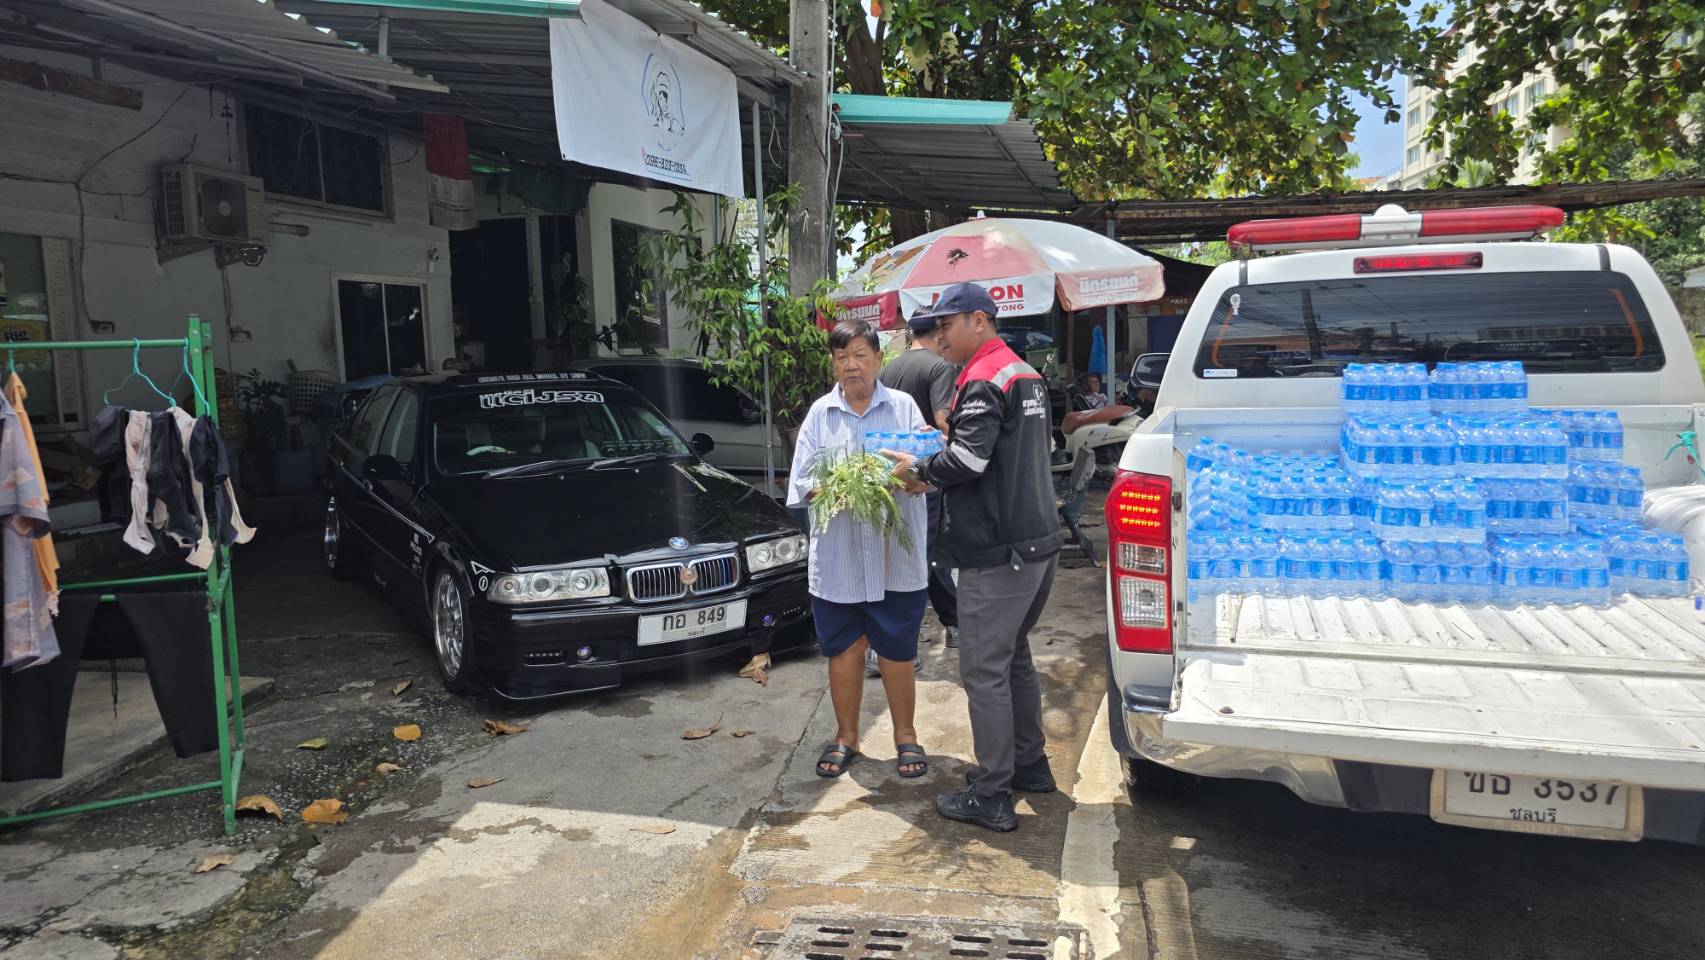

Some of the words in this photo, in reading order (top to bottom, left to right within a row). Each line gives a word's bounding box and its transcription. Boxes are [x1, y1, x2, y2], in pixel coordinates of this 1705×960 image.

[663, 613, 686, 631] กอ
[697, 606, 725, 626] 849
[1510, 807, 1558, 824] ชลบรี
